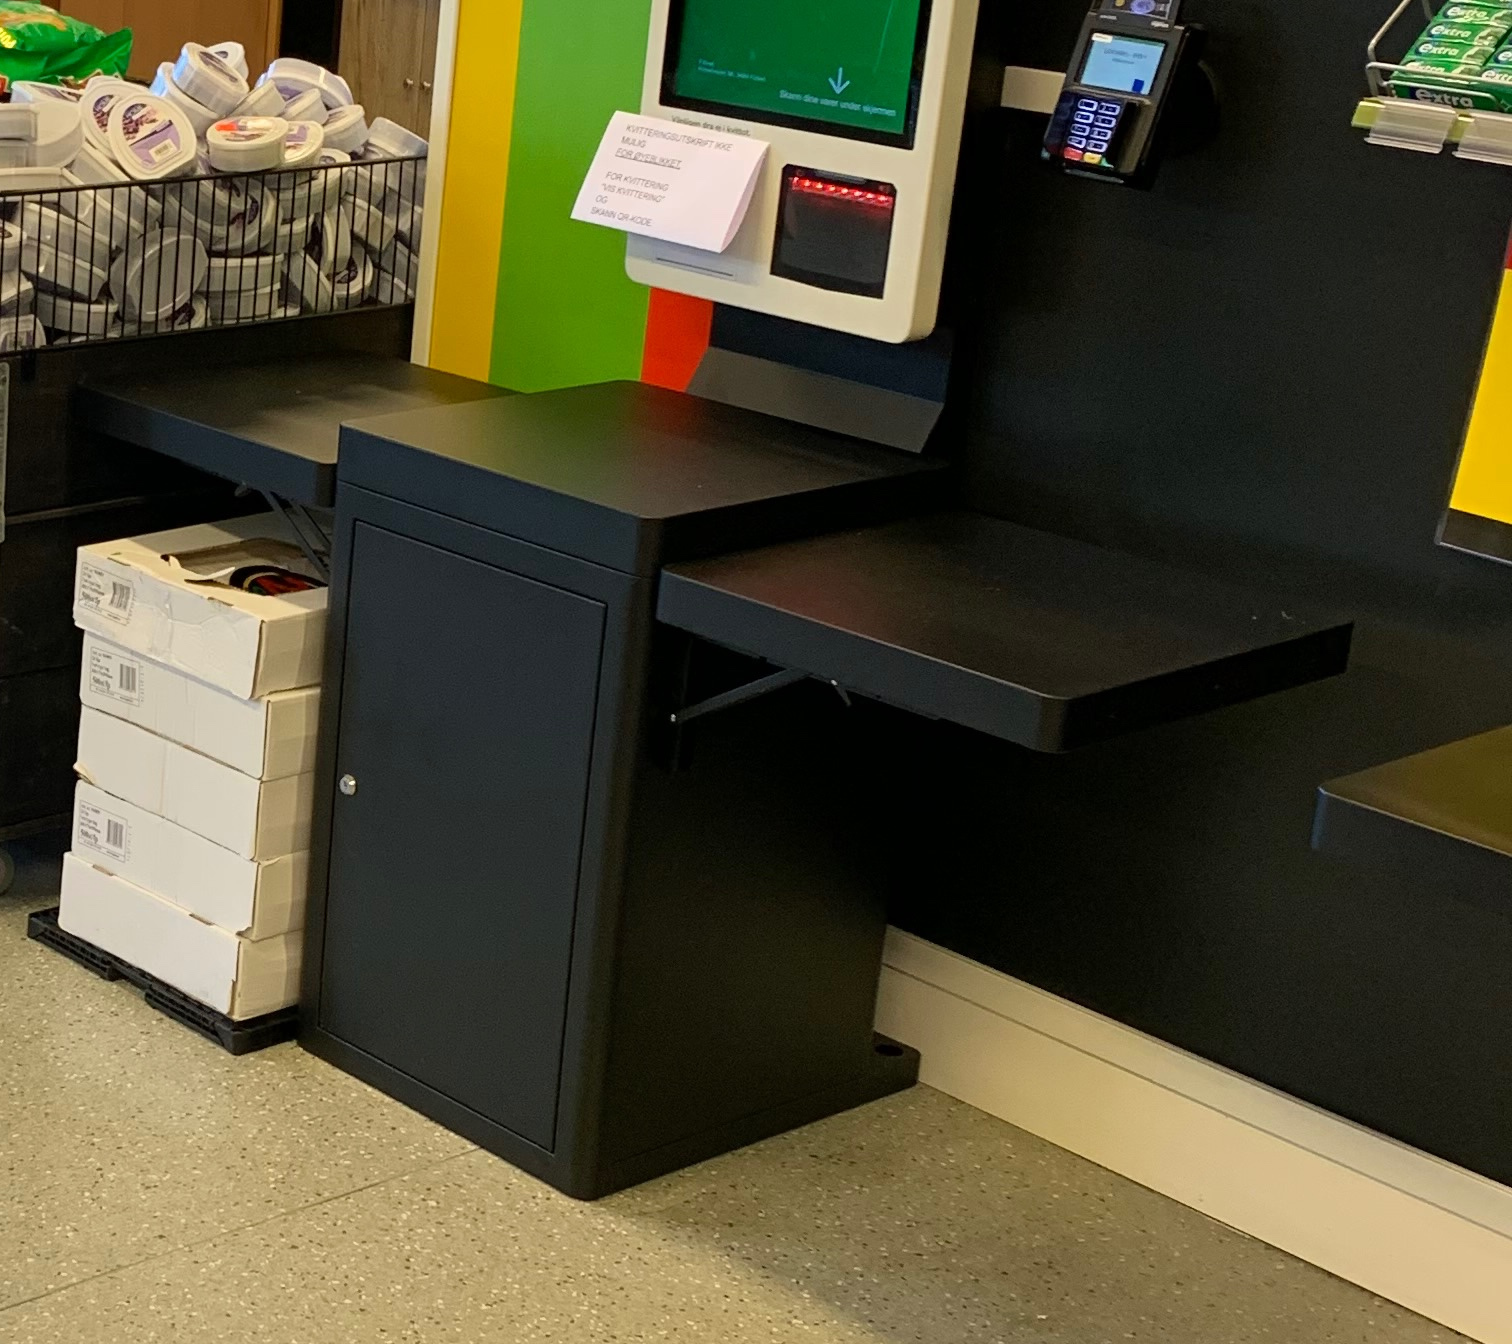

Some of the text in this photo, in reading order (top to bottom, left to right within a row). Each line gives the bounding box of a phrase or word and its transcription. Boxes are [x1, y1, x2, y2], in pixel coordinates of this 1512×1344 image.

[1431, 24, 1472, 38] extra
[1418, 42, 1460, 56] extra
[1415, 88, 1474, 108] extra
[620, 135, 647, 149] MULIG
[626, 124, 734, 153] KVITTERINGSUTSKRIFT IKKE
[616, 147, 634, 159] FOR
[605, 171, 670, 192] FOR KVITTERING
[595, 194, 608, 204] OG
[590, 205, 653, 228] SKANN QR-KODE
